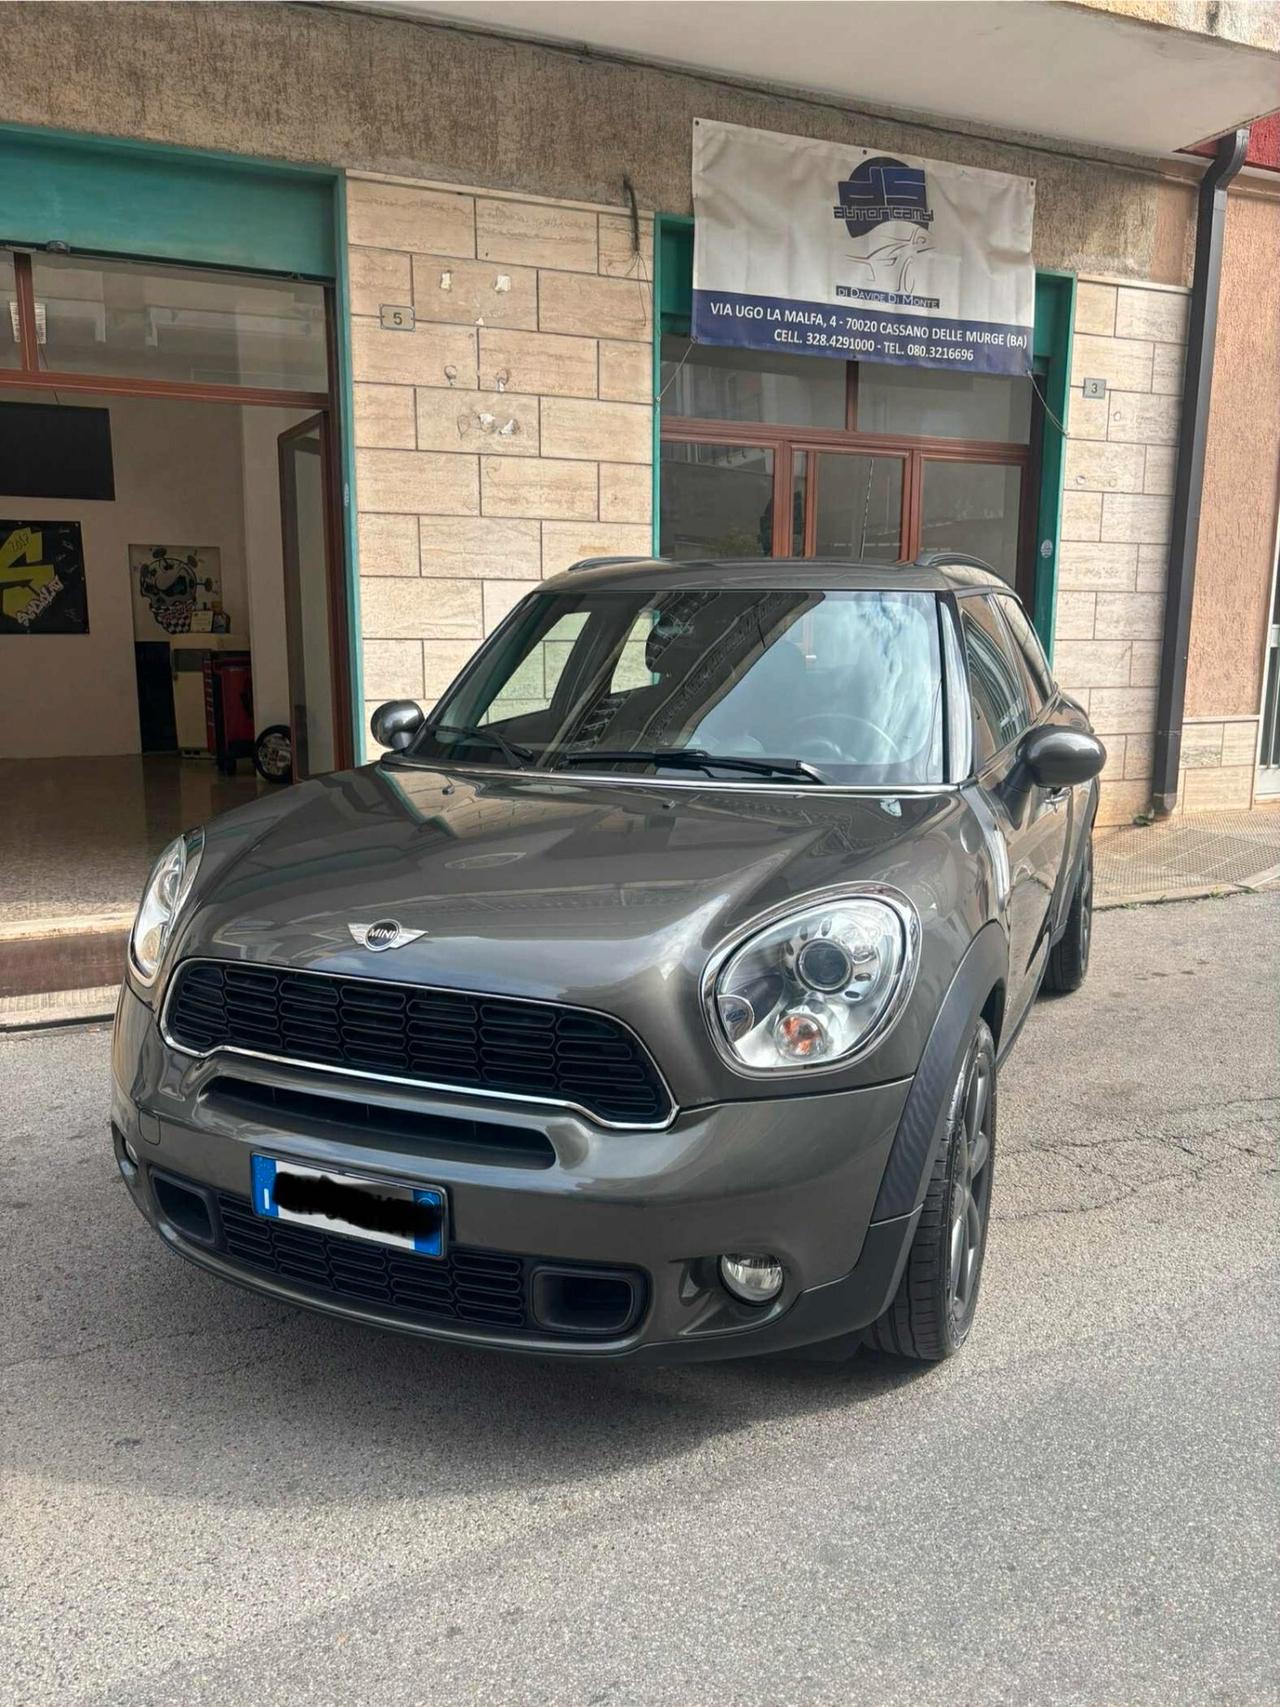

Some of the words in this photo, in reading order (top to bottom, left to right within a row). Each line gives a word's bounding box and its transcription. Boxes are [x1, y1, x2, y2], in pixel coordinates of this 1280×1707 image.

[393, 312, 403, 325] 5
[710, 302, 733, 316] VIA
[735, 305, 764, 319] UGO
[767, 308, 781, 322] LA
[784, 310, 827, 328] MALFA,
[829, 315, 837, 328] 4
[846, 317, 878, 333] 70020
[880, 322, 929, 338] CASSANO
[932, 328, 963, 342] DELLE
[966, 331, 1004, 345] MURGE
[1006, 333, 1028, 349] (BA)
[774, 328, 803, 344] CELL.
[806, 332, 875, 351] 328.4291000
[883, 341, 905, 355] TEL.
[907, 344, 974, 361] 080.3216696
[1091, 382, 1098, 394] 3
[368, 928, 396, 939] MINI
